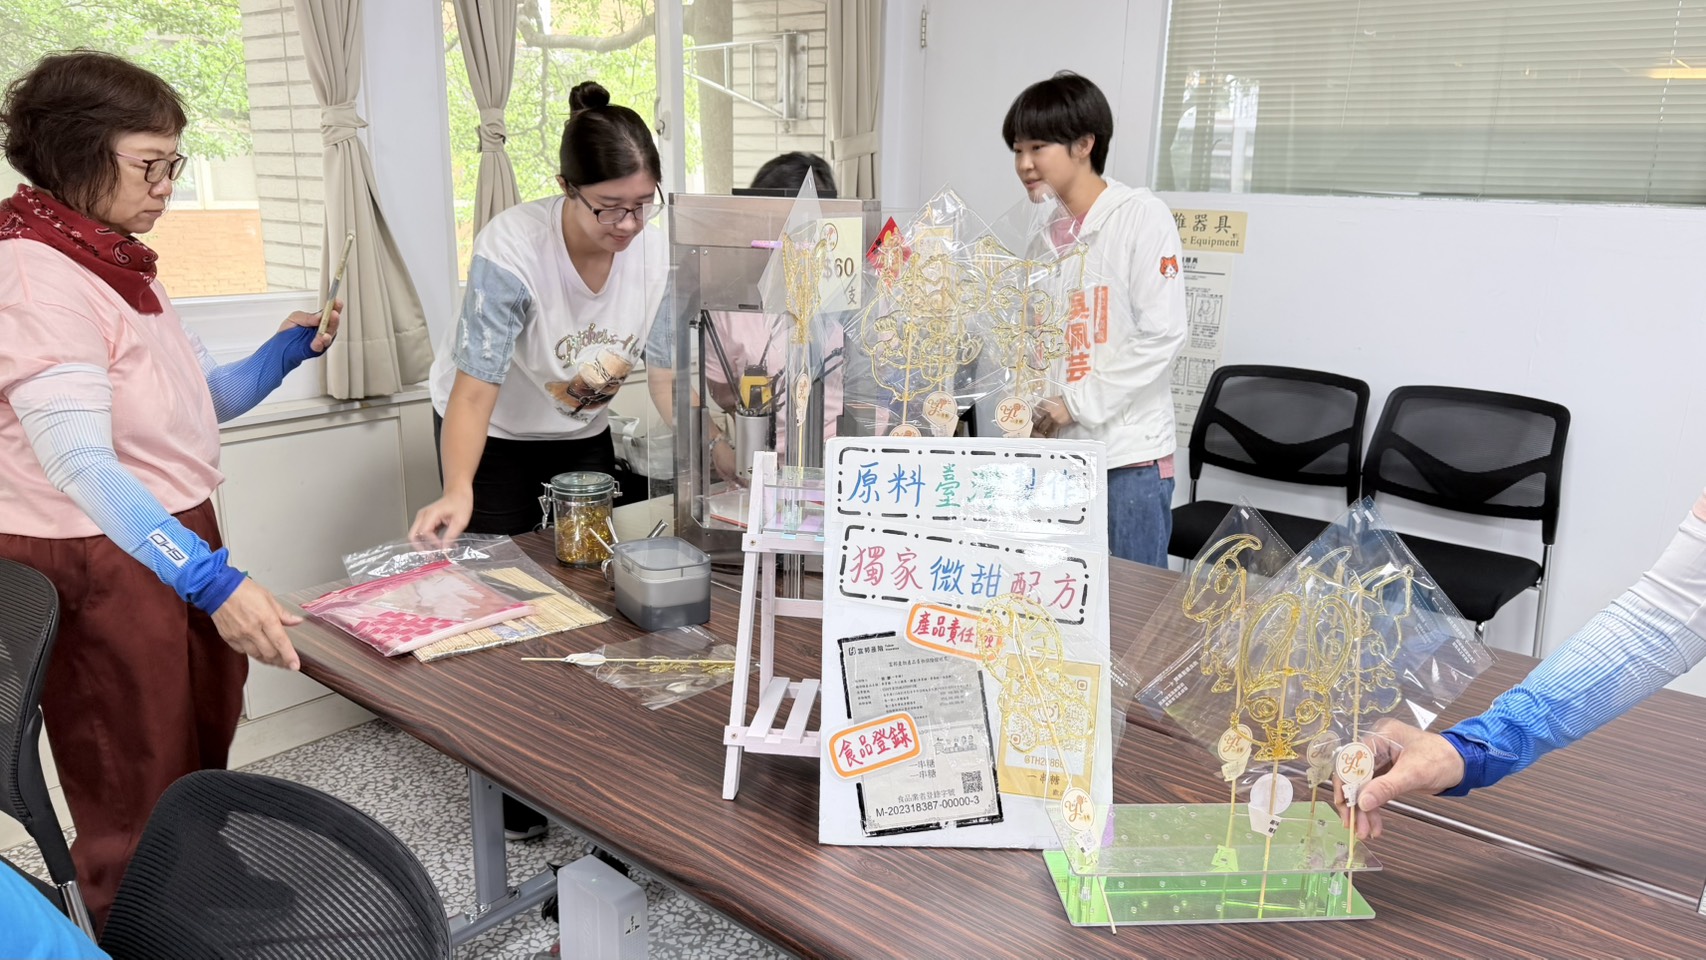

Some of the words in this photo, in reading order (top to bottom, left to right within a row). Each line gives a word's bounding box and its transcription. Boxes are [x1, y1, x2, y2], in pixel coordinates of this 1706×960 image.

[1190, 236, 1240, 248] Equipment
[849, 545, 1078, 610] 獨家微甜配方
[838, 721, 913, 768] 食品登錄
